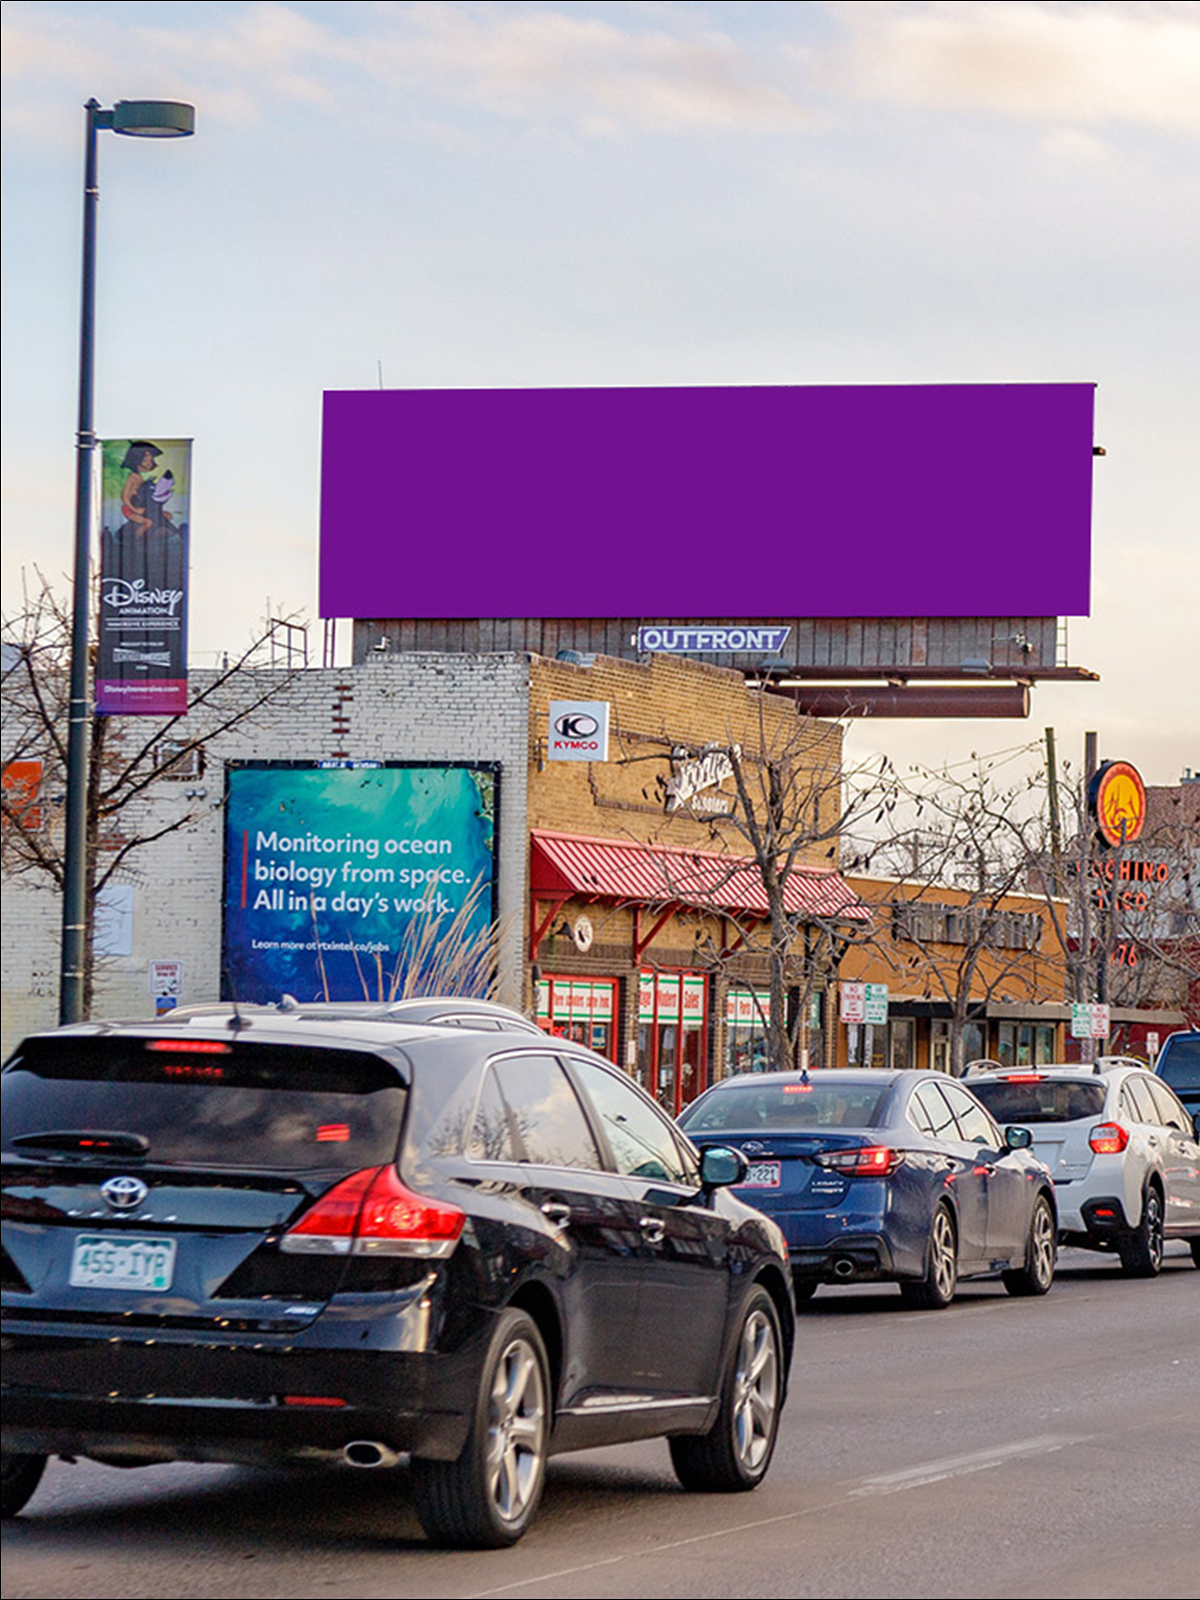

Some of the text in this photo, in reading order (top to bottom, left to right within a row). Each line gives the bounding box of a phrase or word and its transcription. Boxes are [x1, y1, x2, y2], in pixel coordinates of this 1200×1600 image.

[118, 606, 169, 615] ANIMATION
[643, 629, 782, 649] OUTFRONT
[554, 740, 599, 751] KYMCO
[255, 830, 453, 859] Monitoring ocean
[254, 858, 471, 889] biology from space.
[253, 888, 456, 918] All in a day's work.
[252, 939, 279, 949] Learn
[281, 941, 304, 950] more
[306, 942, 316, 950] at
